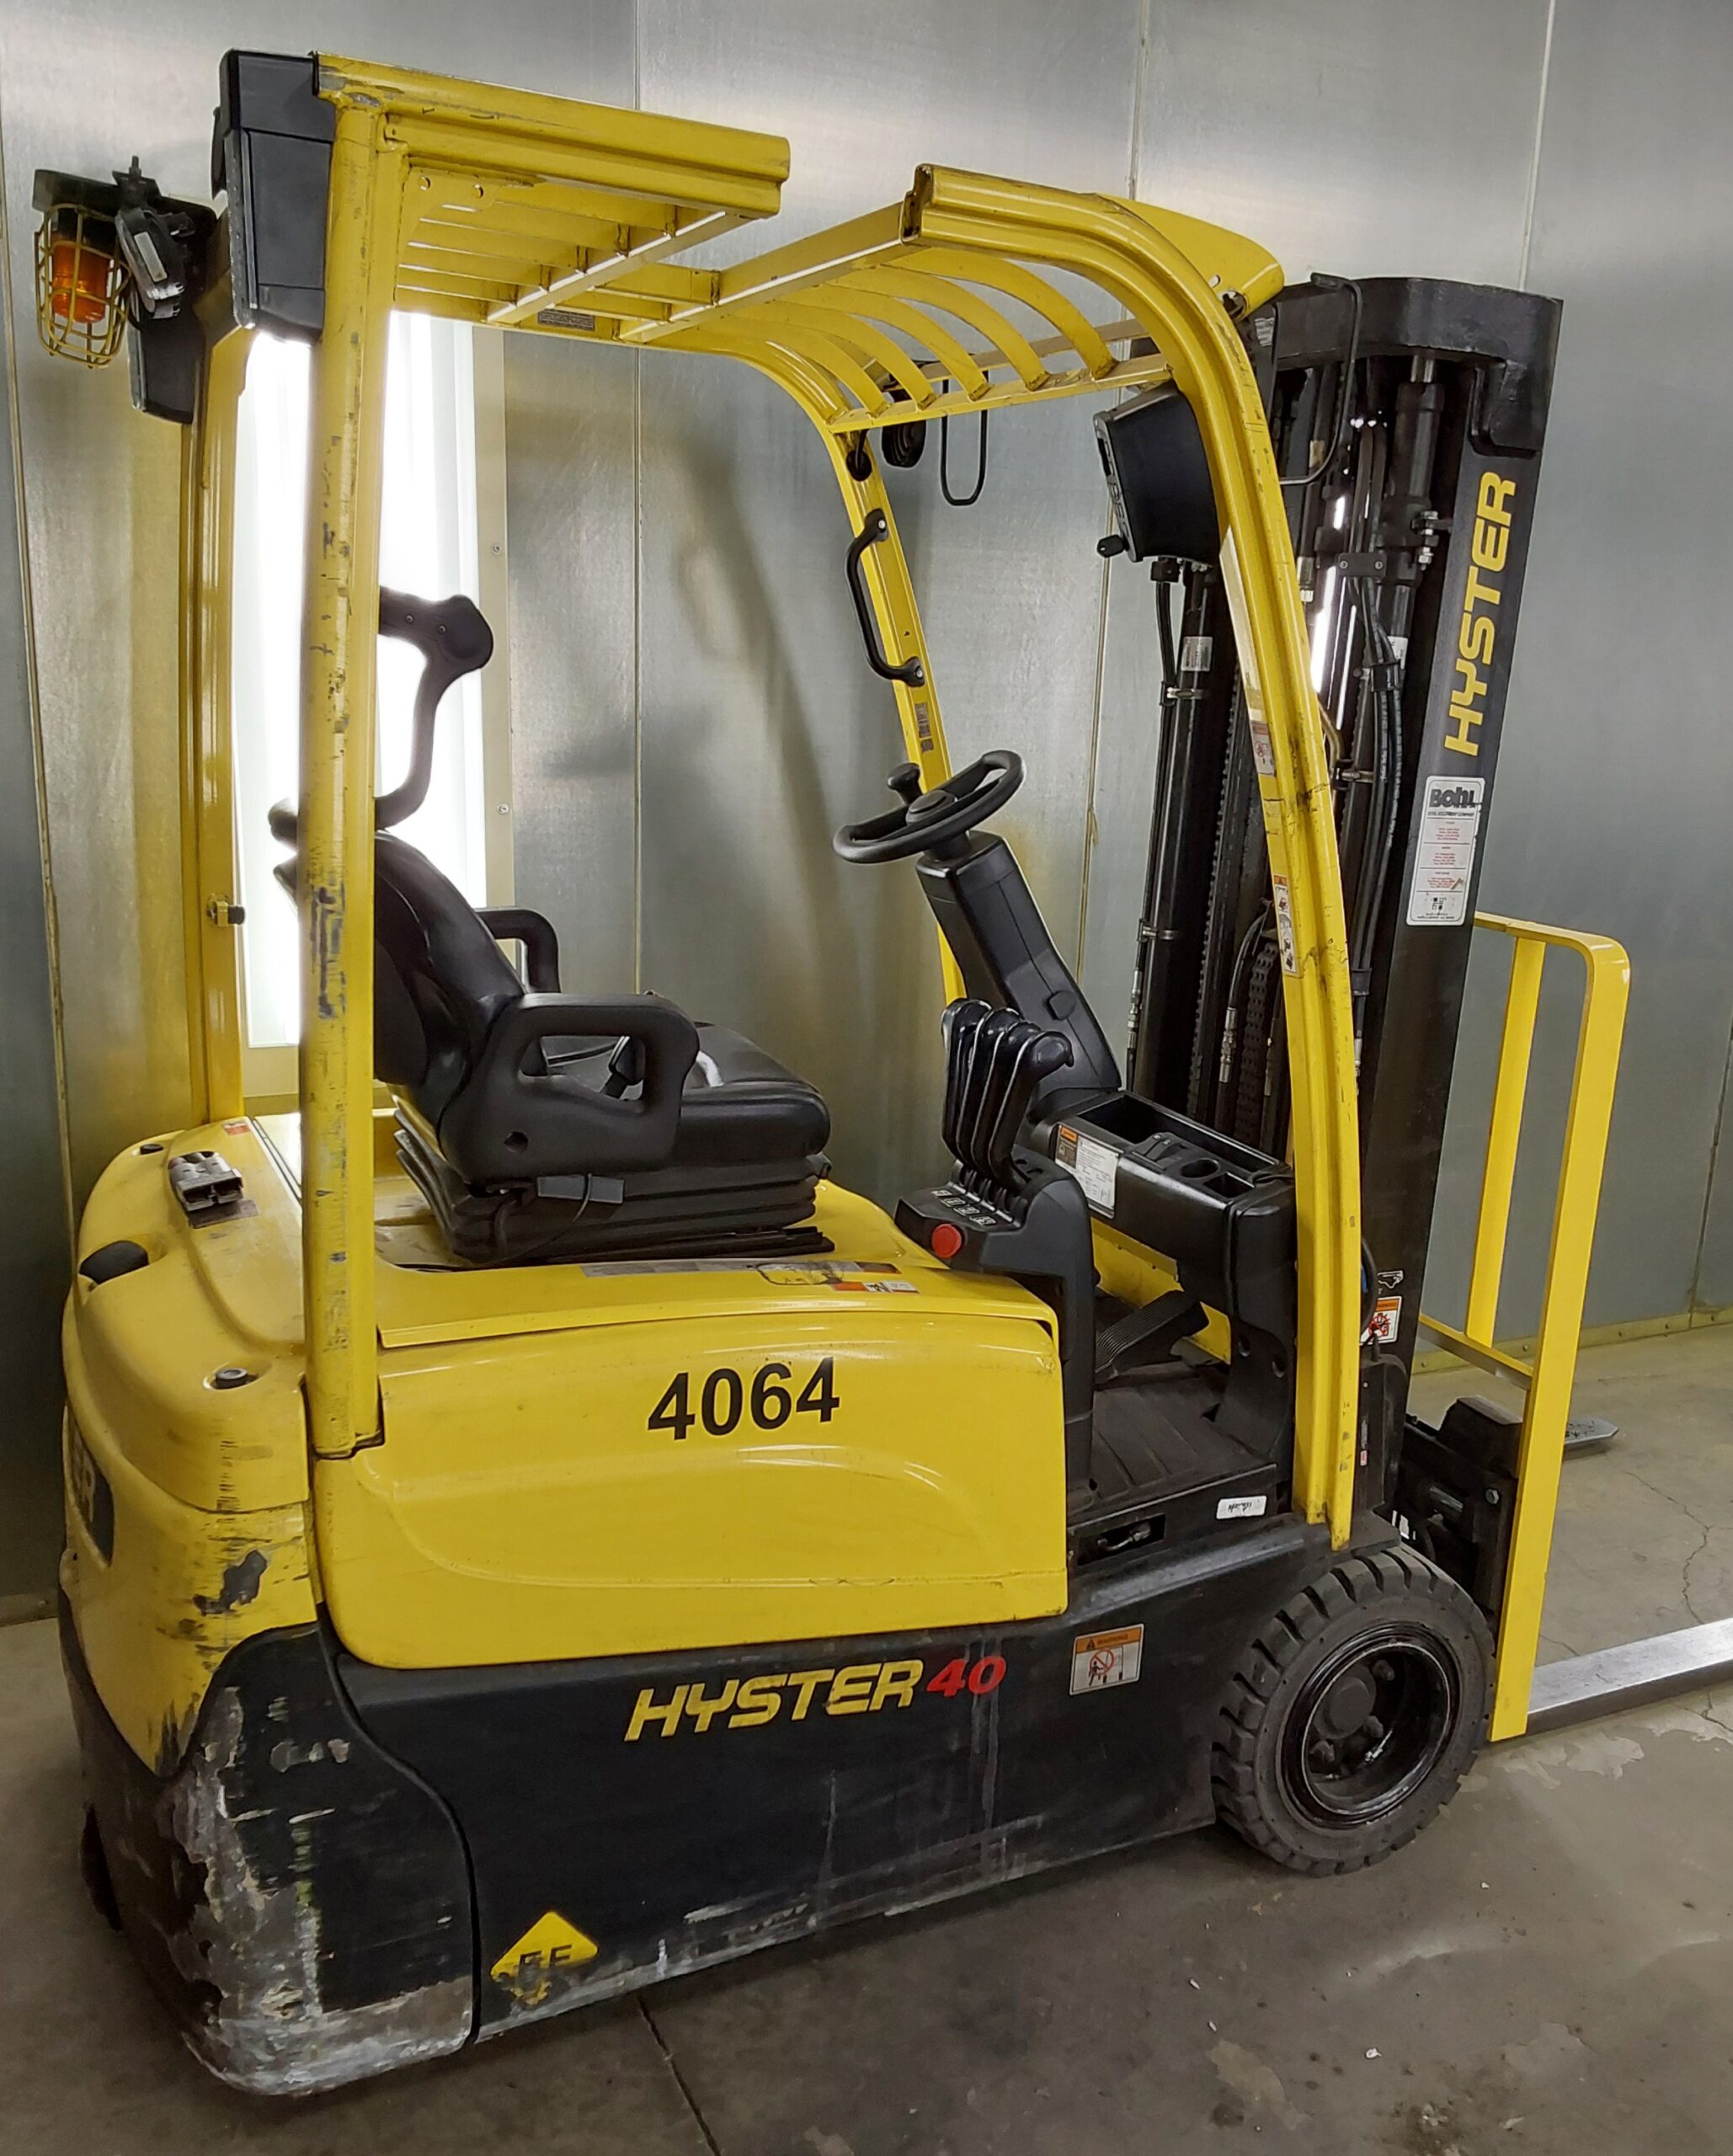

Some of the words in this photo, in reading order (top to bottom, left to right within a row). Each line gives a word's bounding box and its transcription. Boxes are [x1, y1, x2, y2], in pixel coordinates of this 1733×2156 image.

[1444, 472, 1517, 756] HYSTER
[648, 1357, 840, 1440] 4064
[624, 1659, 924, 1742] HYSTER
[926, 1656, 1007, 1697] 40
